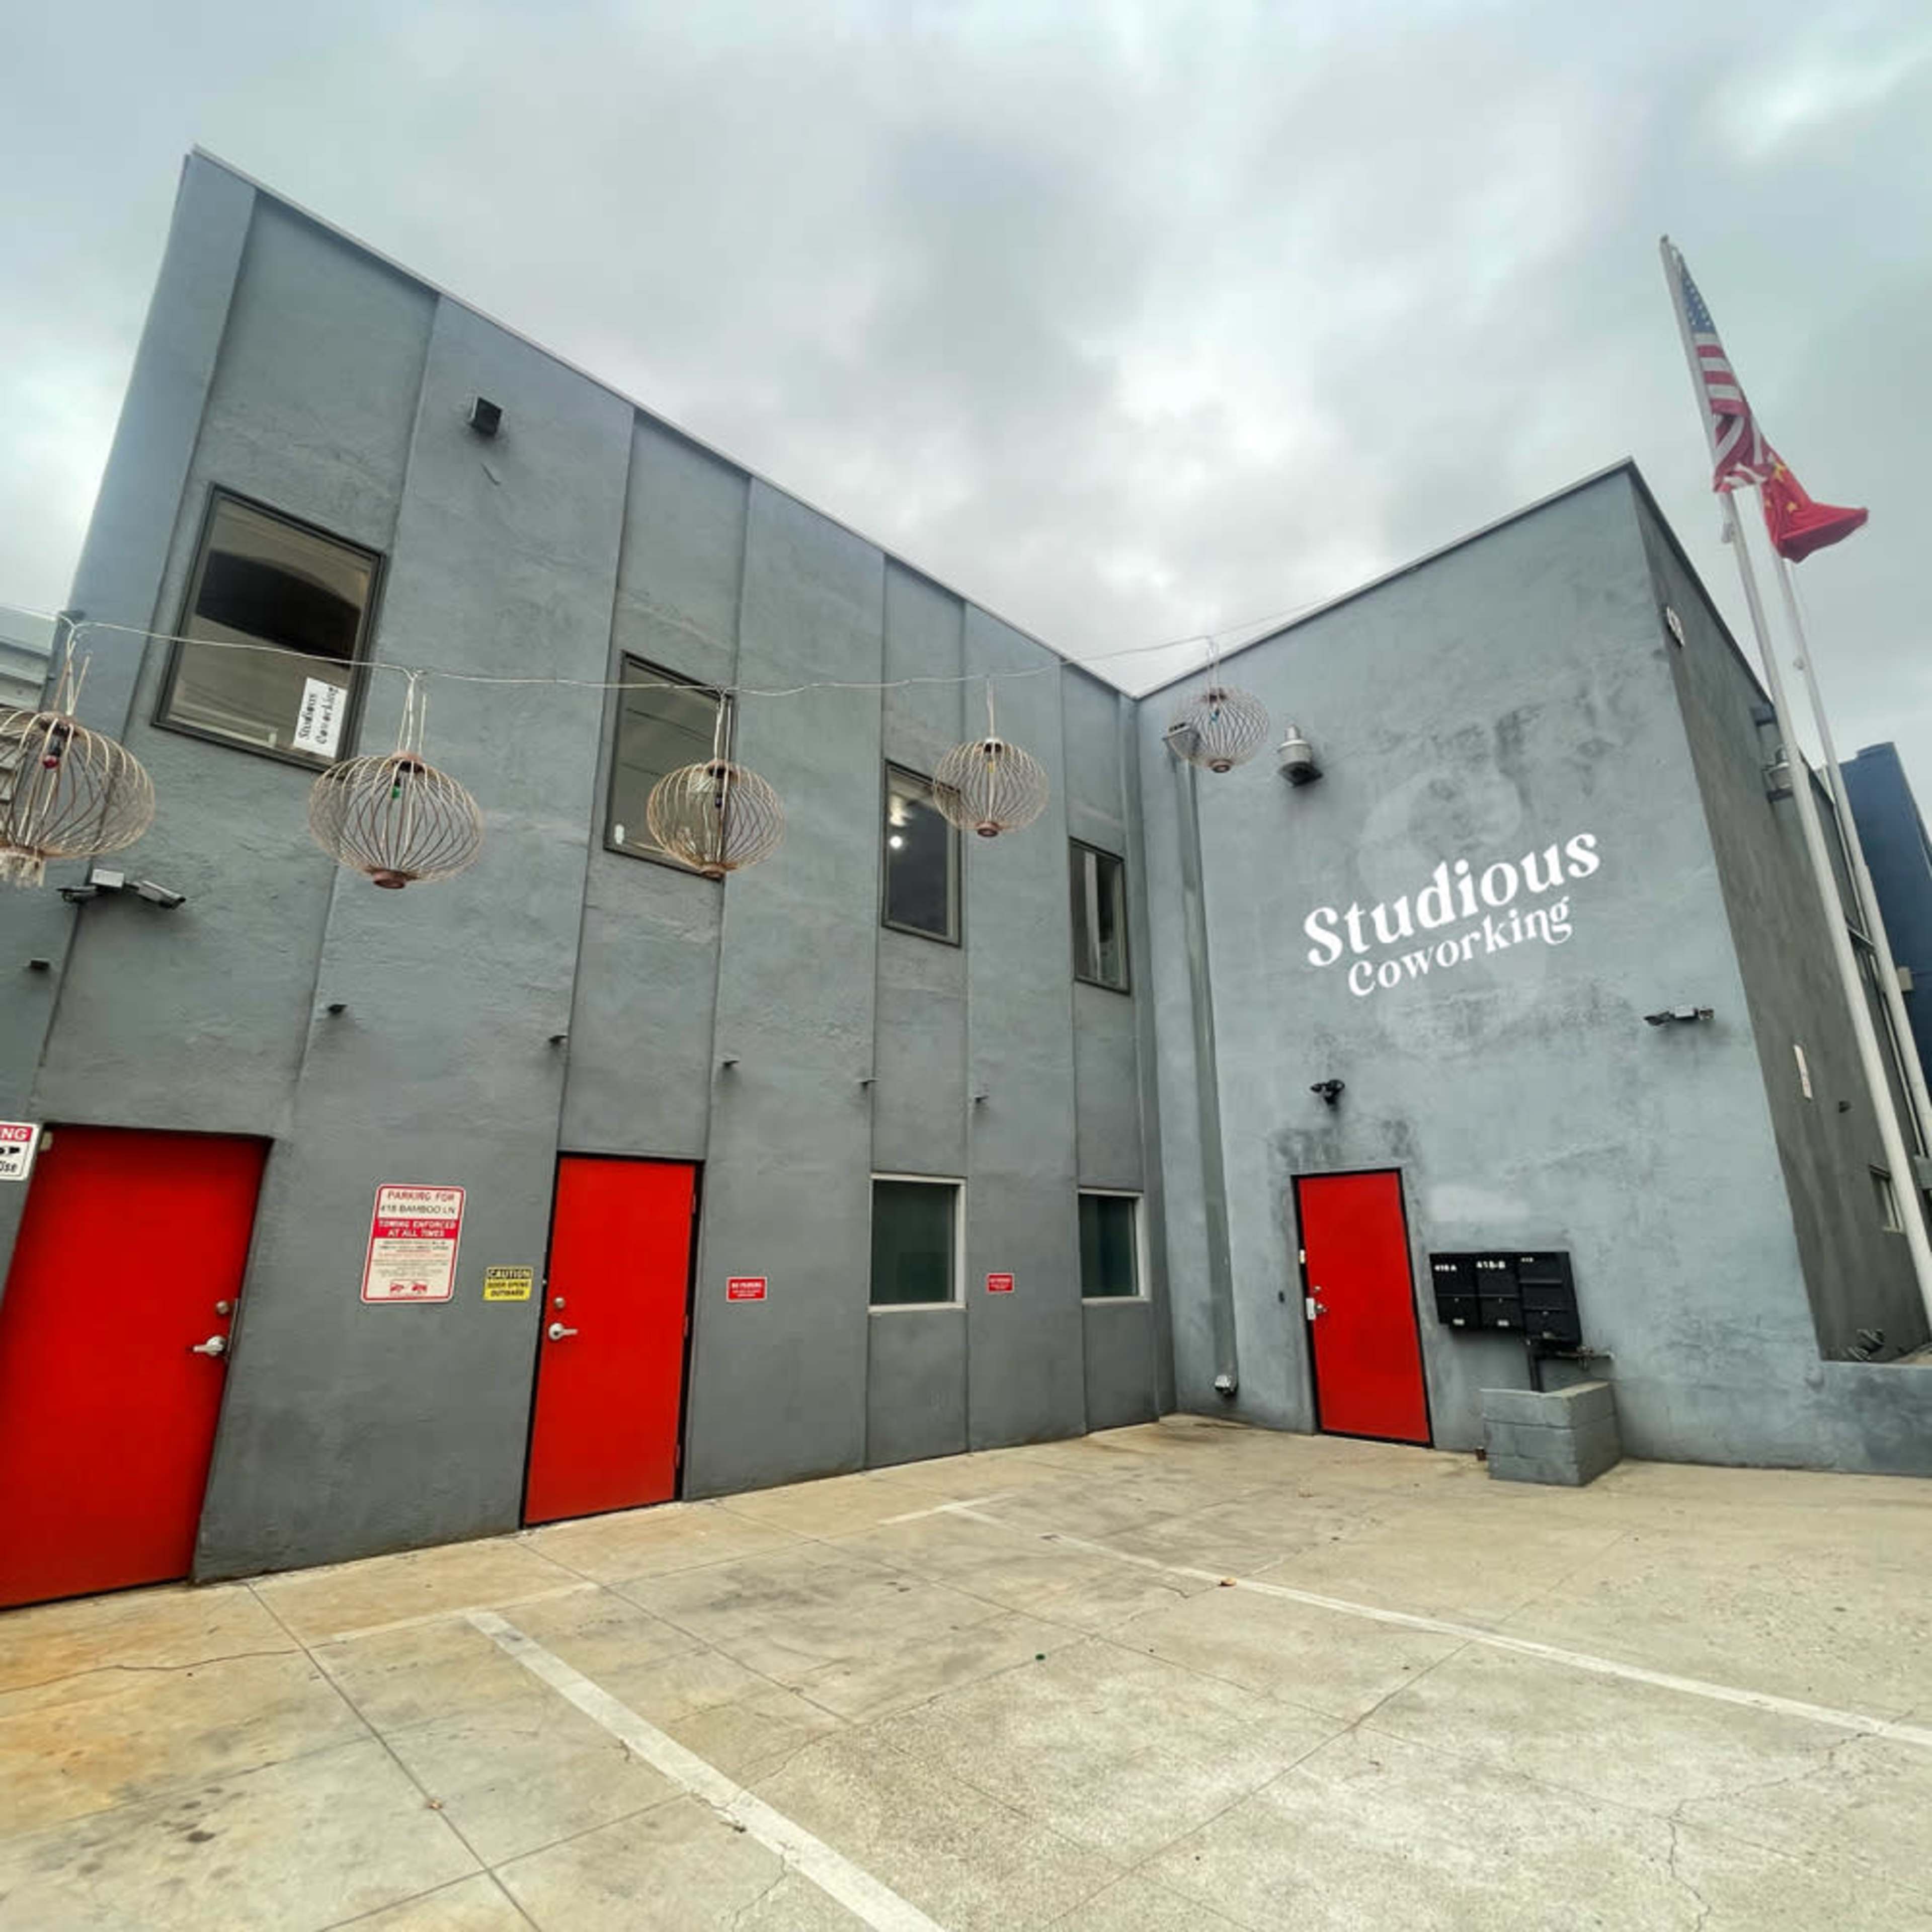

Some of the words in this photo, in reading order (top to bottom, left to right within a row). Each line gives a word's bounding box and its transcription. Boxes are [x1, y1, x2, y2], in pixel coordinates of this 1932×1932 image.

[1304, 833, 1600, 967] Studious
[1348, 896, 1573, 996] Coworking
[388, 1191, 431, 1201] PARKING
[435, 1192, 455, 1201] FOR
[399, 1205, 441, 1214] BAMBOO
[413, 1221, 456, 1229] ENFORCED
[387, 1228, 401, 1237] AT
[401, 1229, 417, 1237] ALL
[488, 1269, 532, 1279] CAUTION
